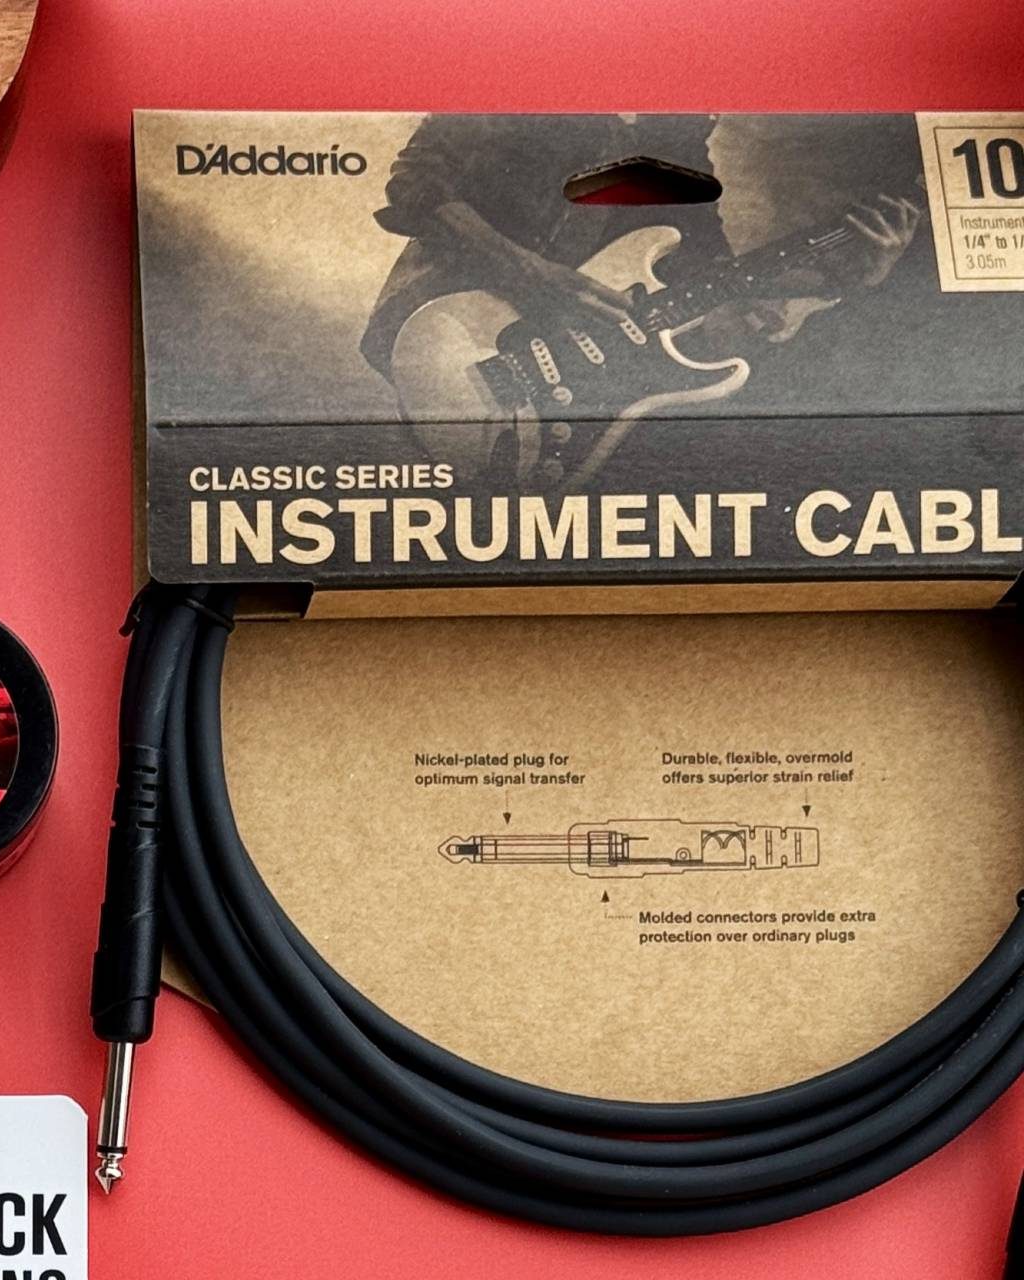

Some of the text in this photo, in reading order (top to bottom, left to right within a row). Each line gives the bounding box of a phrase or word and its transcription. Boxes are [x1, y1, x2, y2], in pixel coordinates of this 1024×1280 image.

[953, 138, 1024, 199] 10
[995, 236, 1007, 249] to
[189, 464, 453, 491] CLASSIC SERIES
[190, 492, 767, 565] INSTRUMENT
[415, 753, 569, 768] Nickel-plated plug for
[662, 751, 853, 766] Durable, flexible, overmold
[415, 771, 585, 787] optimum signal transfer
[662, 769, 854, 785] offers superior strain relief
[639, 910, 876, 925] Molded connectors provide extra
[639, 929, 856, 945] protection over ordinary plugs
